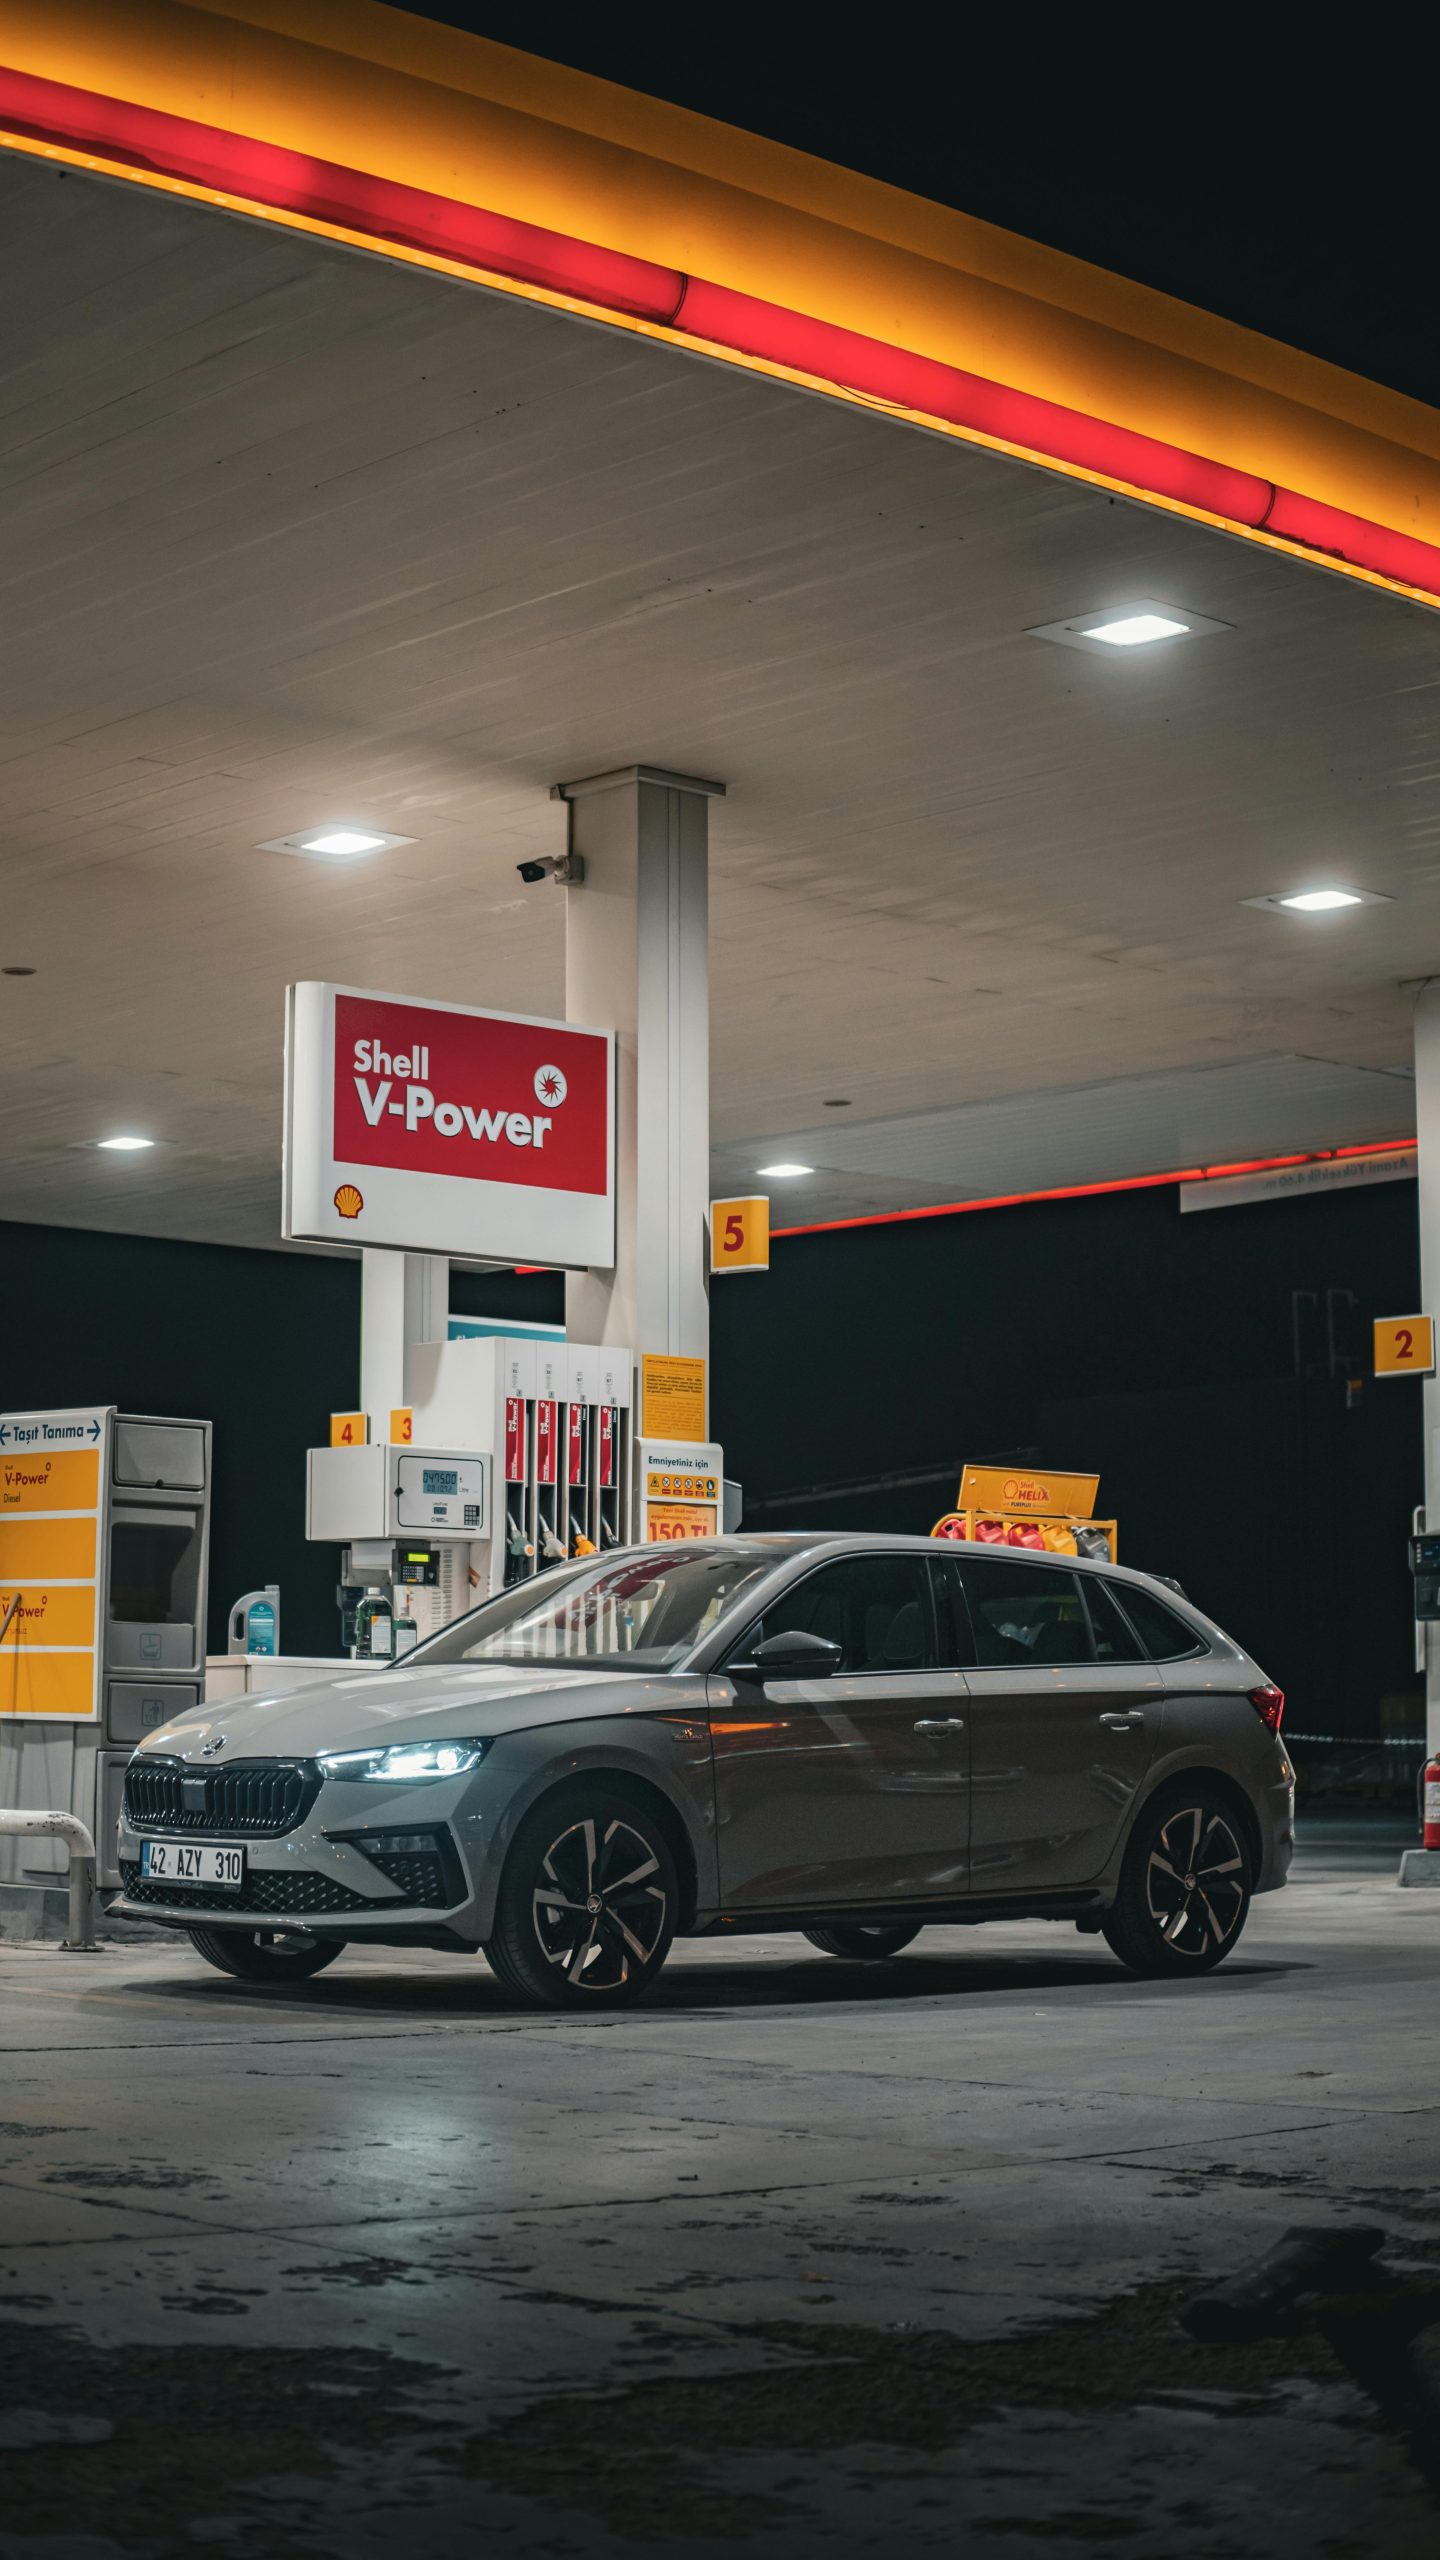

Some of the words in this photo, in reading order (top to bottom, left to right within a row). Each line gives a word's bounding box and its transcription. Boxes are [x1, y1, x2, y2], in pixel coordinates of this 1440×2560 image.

[353, 1039, 429, 1080] Shell
[353, 1077, 552, 1149] V-Power
[723, 1215, 745, 1252] 5
[1394, 1329, 1413, 1359] 2
[13, 1426, 39, 1445] Taşıt
[42, 1424, 84, 1440] Tanıma
[341, 1423, 353, 1445] 4
[402, 1417, 412, 1440] 3
[648, 1456, 693, 1468] Emniyetiniz
[695, 1459, 709, 1469] için
[5, 1472, 48, 1486] V-Power
[4, 1491, 21, 1503] Diesel
[1018, 1488, 1049, 1501] HELIX
[650, 1522, 686, 1542] 150
[2, 1603, 46, 1618] VPower
[150, 1846, 166, 1875] 42
[177, 1848, 202, 1877] AZY
[216, 1852, 240, 1880] 310
